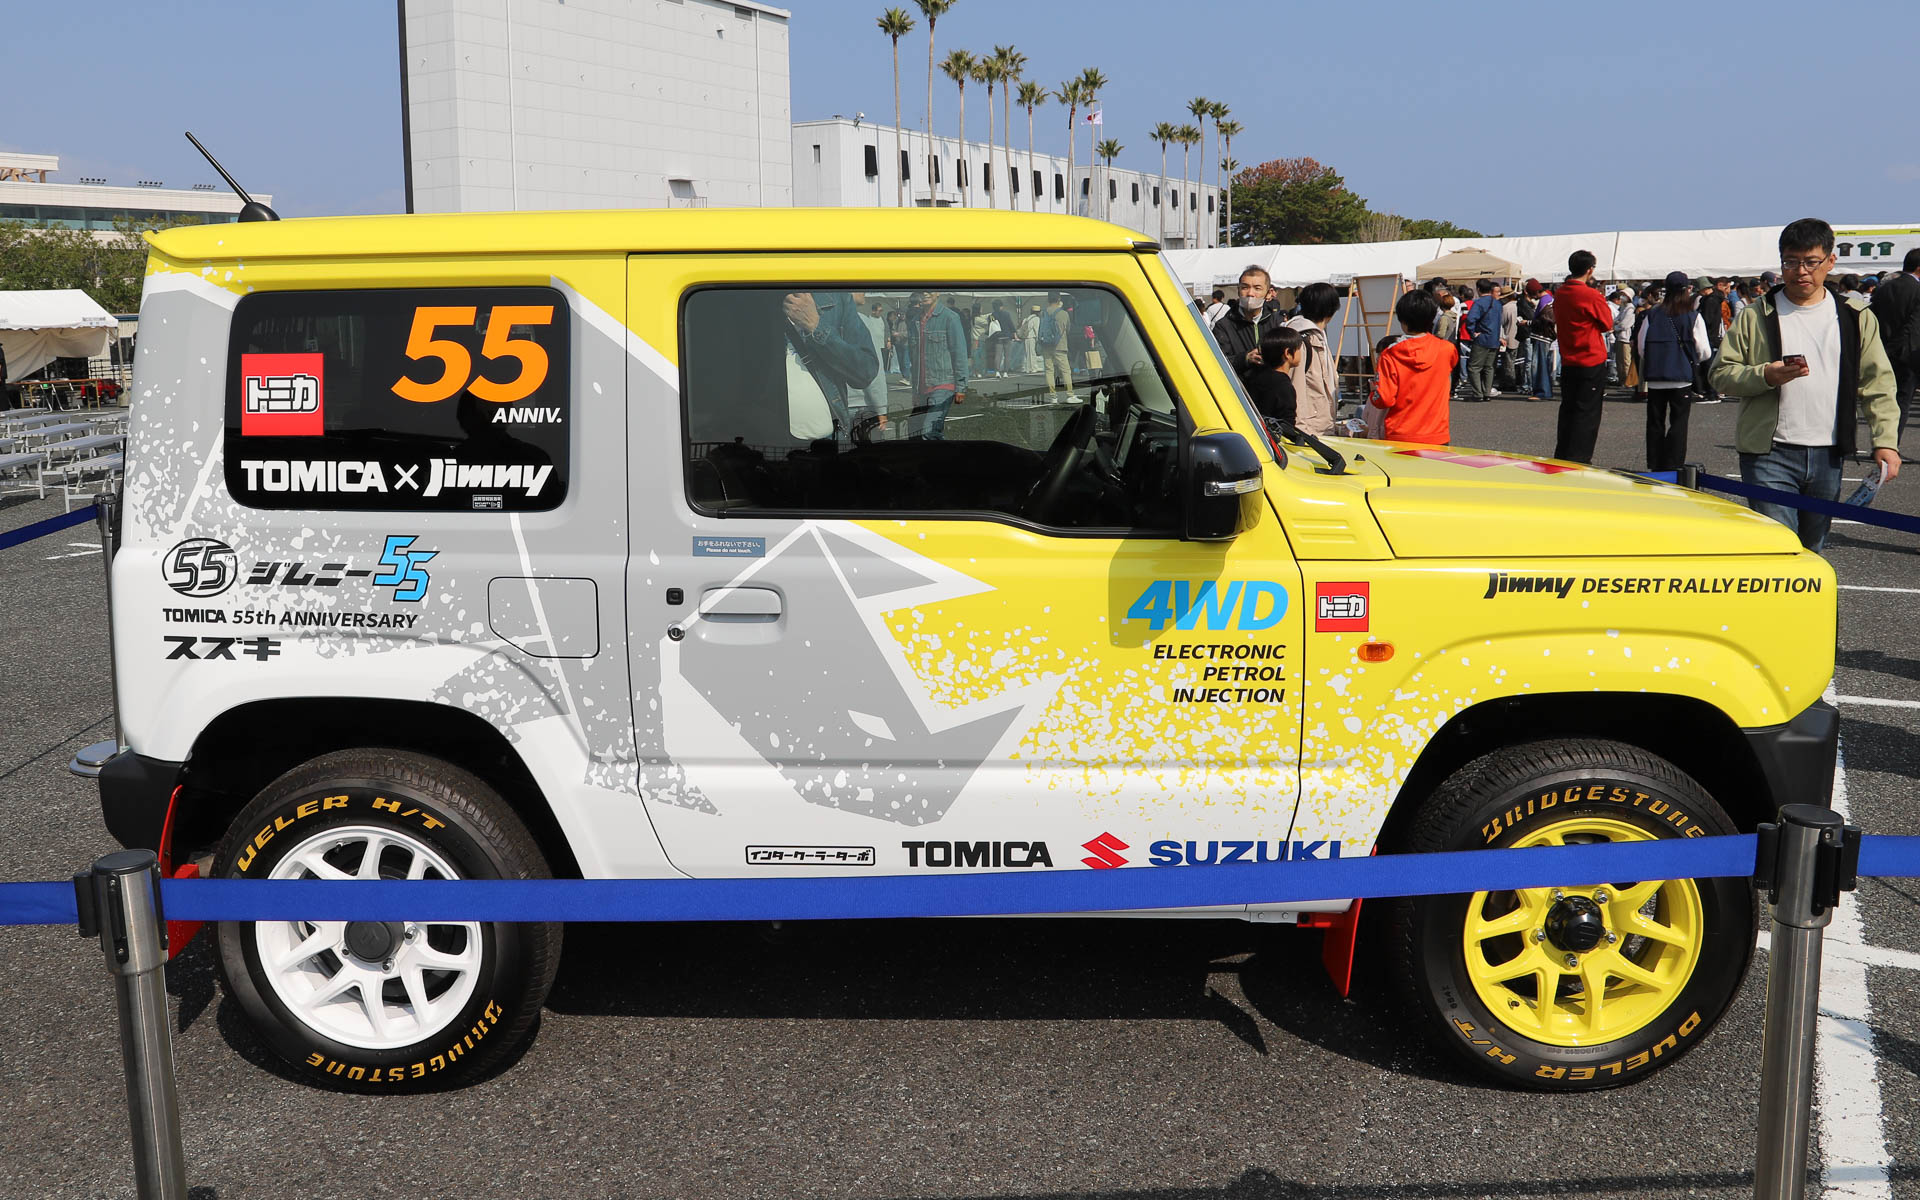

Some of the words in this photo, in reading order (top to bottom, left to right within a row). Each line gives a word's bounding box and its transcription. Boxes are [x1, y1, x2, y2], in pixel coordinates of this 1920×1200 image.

[390, 305, 555, 403] 55
[246, 373, 320, 414] トミカ
[491, 407, 562, 424] ANNIV.
[241, 459, 388, 493] TOMICA
[422, 458, 554, 497] Jimny
[246, 561, 372, 587] ジムニー
[372, 534, 441, 602] 55
[1483, 573, 1576, 599] Jimny
[1582, 577, 1666, 594] DESERT
[1668, 577, 1735, 594] RALLY
[1736, 577, 1822, 593] EDITION
[163, 608, 227, 624] TOMICA
[232, 610, 276, 625] 55th
[279, 611, 418, 629] ANNIVERSARY
[1127, 580, 1289, 631] 4WD
[1318, 594, 1367, 619] トミカ
[163, 636, 281, 661] スズキ
[1153, 644, 1287, 660] ELECTRONIC
[1202, 666, 1287, 681] PETROL
[1172, 688, 1286, 703] INJECTION
[236, 795, 350, 873] UELER
[371, 797, 447, 830] H/T
[750, 849, 871, 862] インタークーラーターボ
[901, 841, 1054, 868] TOMICA
[1148, 840, 1342, 867] SUZUKI
[1452, 1017, 1518, 1066] H/T
[1535, 1011, 1703, 1081] DUELER
